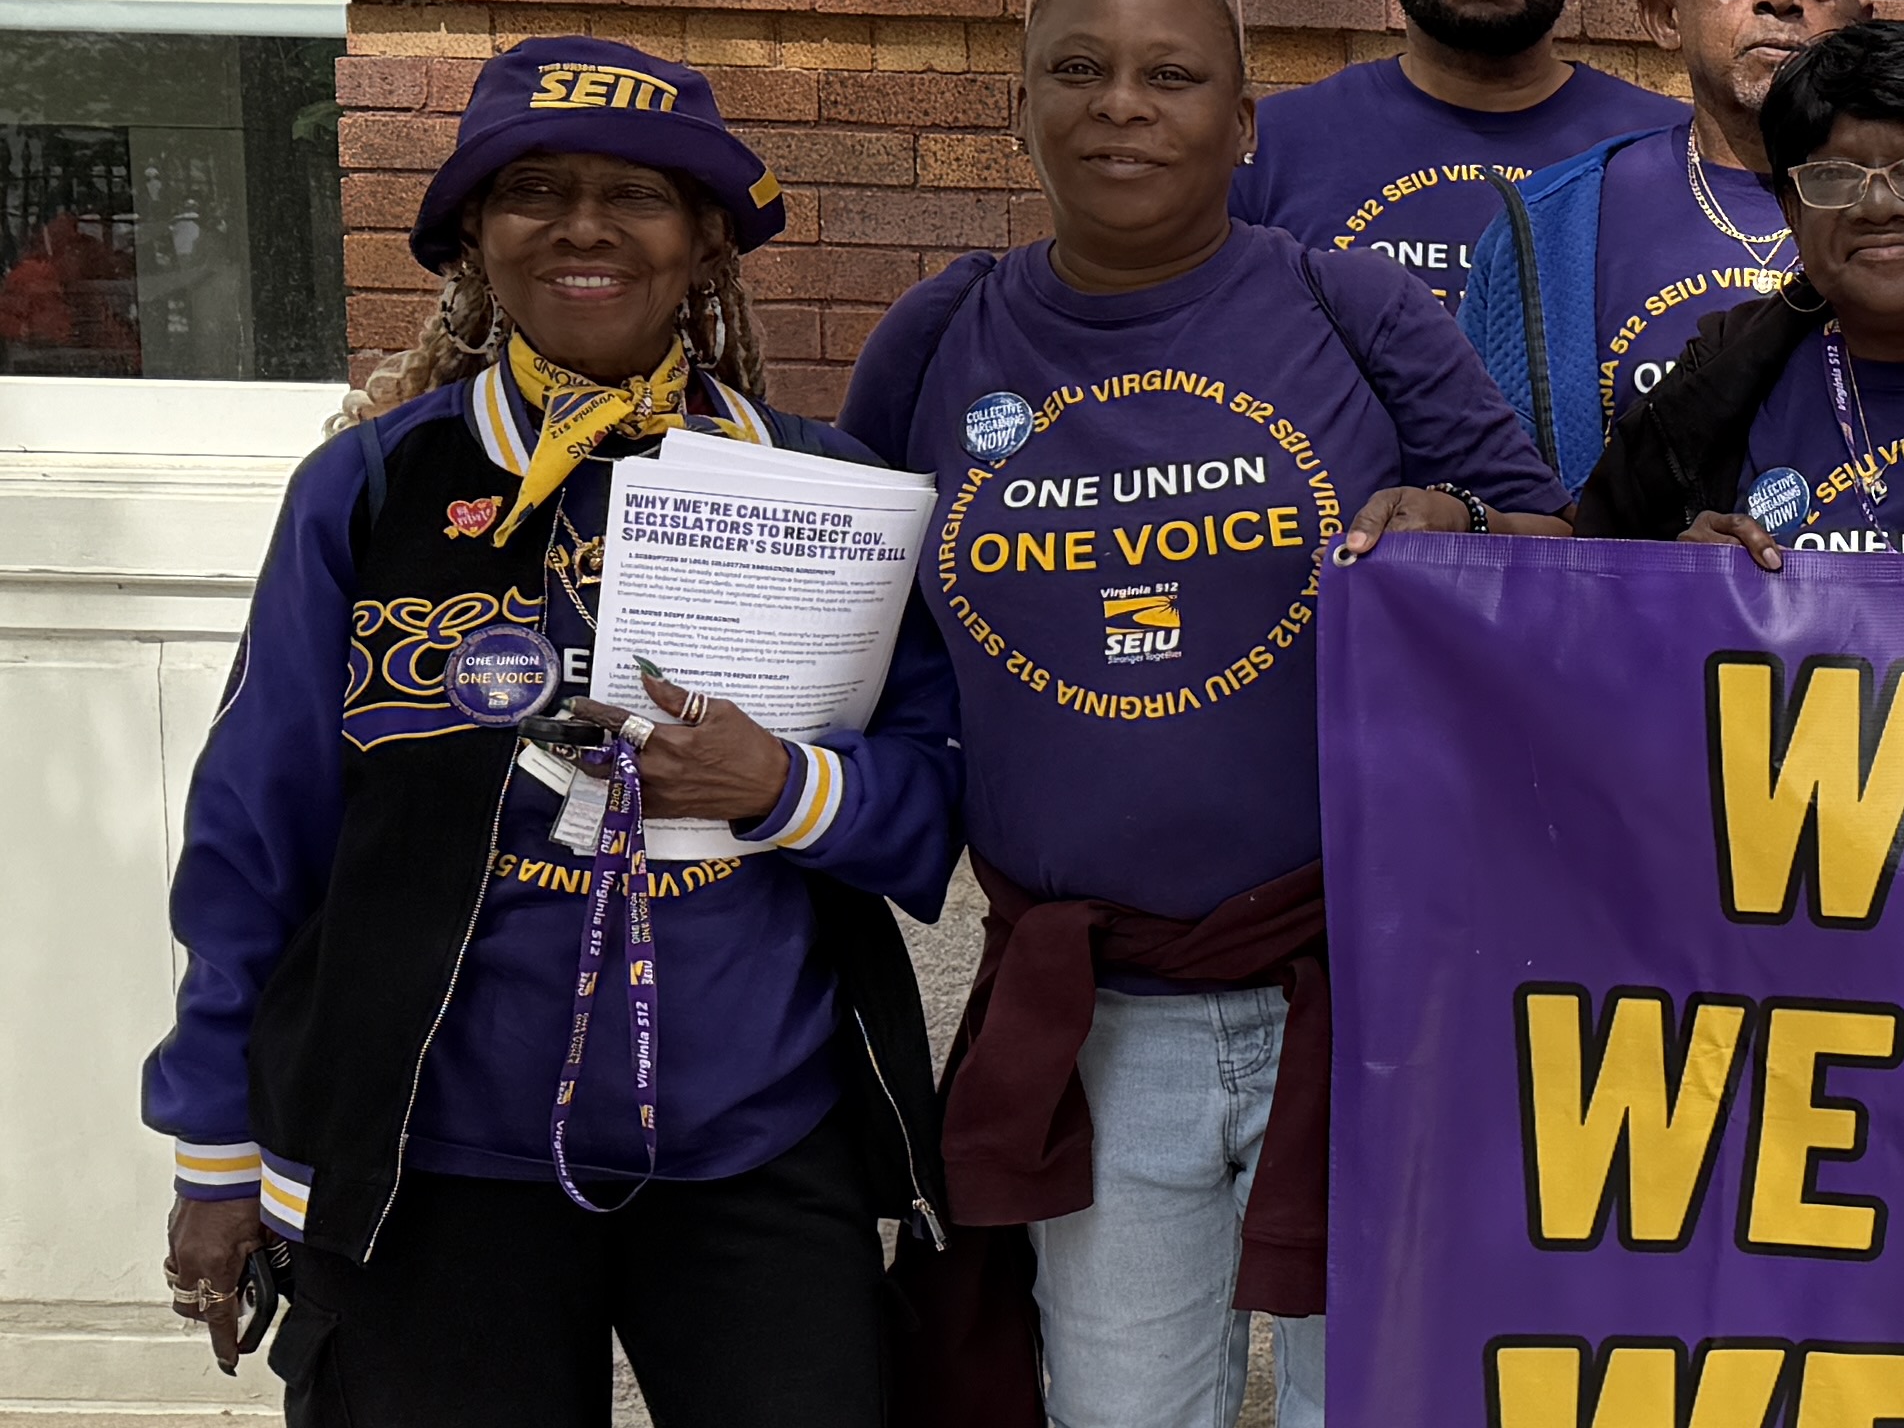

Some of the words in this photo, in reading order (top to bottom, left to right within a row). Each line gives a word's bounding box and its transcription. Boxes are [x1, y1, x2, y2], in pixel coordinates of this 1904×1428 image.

[530, 71, 676, 112] SEIU
[1346, 199, 1384, 232] 512
[1382, 168, 1439, 203] SEIU
[1610, 315, 1647, 354] 512
[1645, 274, 1708, 316] SEIU
[1091, 368, 1226, 405] VIRGINIA
[1032, 385, 1084, 433] SEIU
[1229, 391, 1275, 425] 512
[977, 427, 1016, 452] NOW!
[1269, 418, 1322, 470] SEIU
[1003, 475, 1101, 509] ONE
[1113, 456, 1266, 503] UNION
[623, 509, 753, 538] LEGISLATORS
[757, 523, 780, 539] TO
[784, 525, 850, 544] REJECT
[851, 531, 886, 546] GOV.
[625, 492, 669, 511] WHY
[673, 498, 733, 518] WE'RE
[736, 504, 817, 525] CALLING
[821, 512, 852, 528] FOR
[939, 468, 993, 592] VIRGINIA
[1764, 500, 1798, 532] NOW!
[621, 527, 767, 555] SPANBERGER'S
[770, 541, 875, 561] SUBSTITUTE
[877, 545, 906, 561] BILL
[970, 530, 1097, 572] ONE
[1112, 506, 1304, 566] VOICE
[1100, 585, 1151, 598] Virginia
[1155, 581, 1179, 593] 512
[949, 595, 1006, 657] SEIU
[1104, 628, 1180, 655] SEIU
[1267, 601, 1312, 648] 512
[458, 672, 493, 685] ONE
[496, 671, 545, 685] VOICE
[465, 654, 493, 667] ONE
[496, 654, 540, 666] UNION
[1005, 650, 1051, 692] 512
[1205, 645, 1274, 702] SEIU
[1057, 679, 1201, 720] VIRGINIA
[593, 870, 616, 925] Virginia
[589, 930, 603, 957] 512
[636, 1001, 649, 1028] 512
[635, 1030, 652, 1089] Virginia
